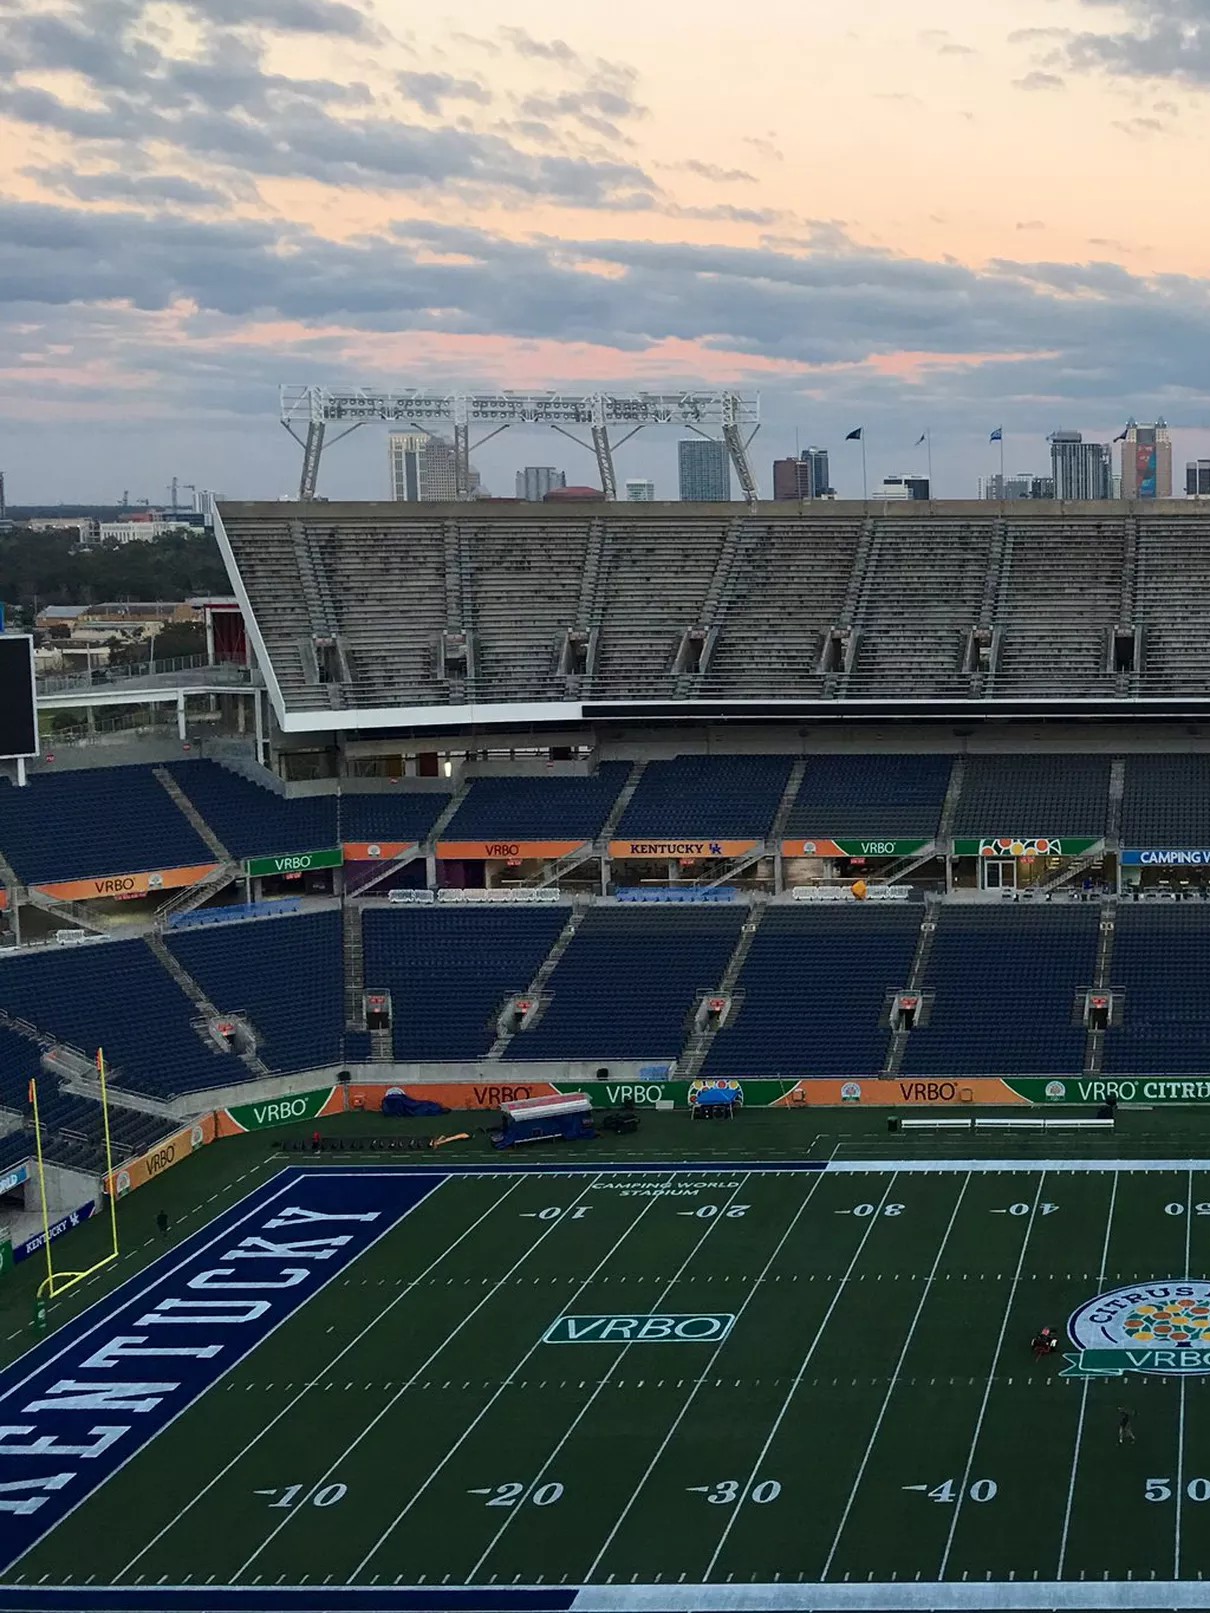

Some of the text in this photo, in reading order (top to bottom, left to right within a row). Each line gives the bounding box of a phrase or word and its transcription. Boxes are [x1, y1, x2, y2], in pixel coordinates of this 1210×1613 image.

[485, 844, 519, 856] VRBO
[631, 844, 703, 854] KENTUCKY
[861, 842, 894, 854] VRBO
[1140, 851, 1200, 864] CAMPING
[275, 856, 311, 871] VRBO
[95, 877, 135, 893] VRBO
[474, 1086, 530, 1104] VRBO
[606, 1086, 662, 1104] VRBO
[900, 1083, 955, 1100] VRBO
[1078, 1081, 1135, 1100] VRBO
[253, 1099, 306, 1123] VRBO
[145, 1144, 175, 1175] VRBO
[26, 1220, 67, 1254] KENTUCKY
[1088, 1287, 1194, 1324] CITRUS
[567, 1317, 721, 1340] VRBO
[269, 1482, 348, 1508] 10
[485, 1482, 565, 1506] 20
[707, 1480, 782, 1504] 30
[927, 1479, 998, 1502] 40
